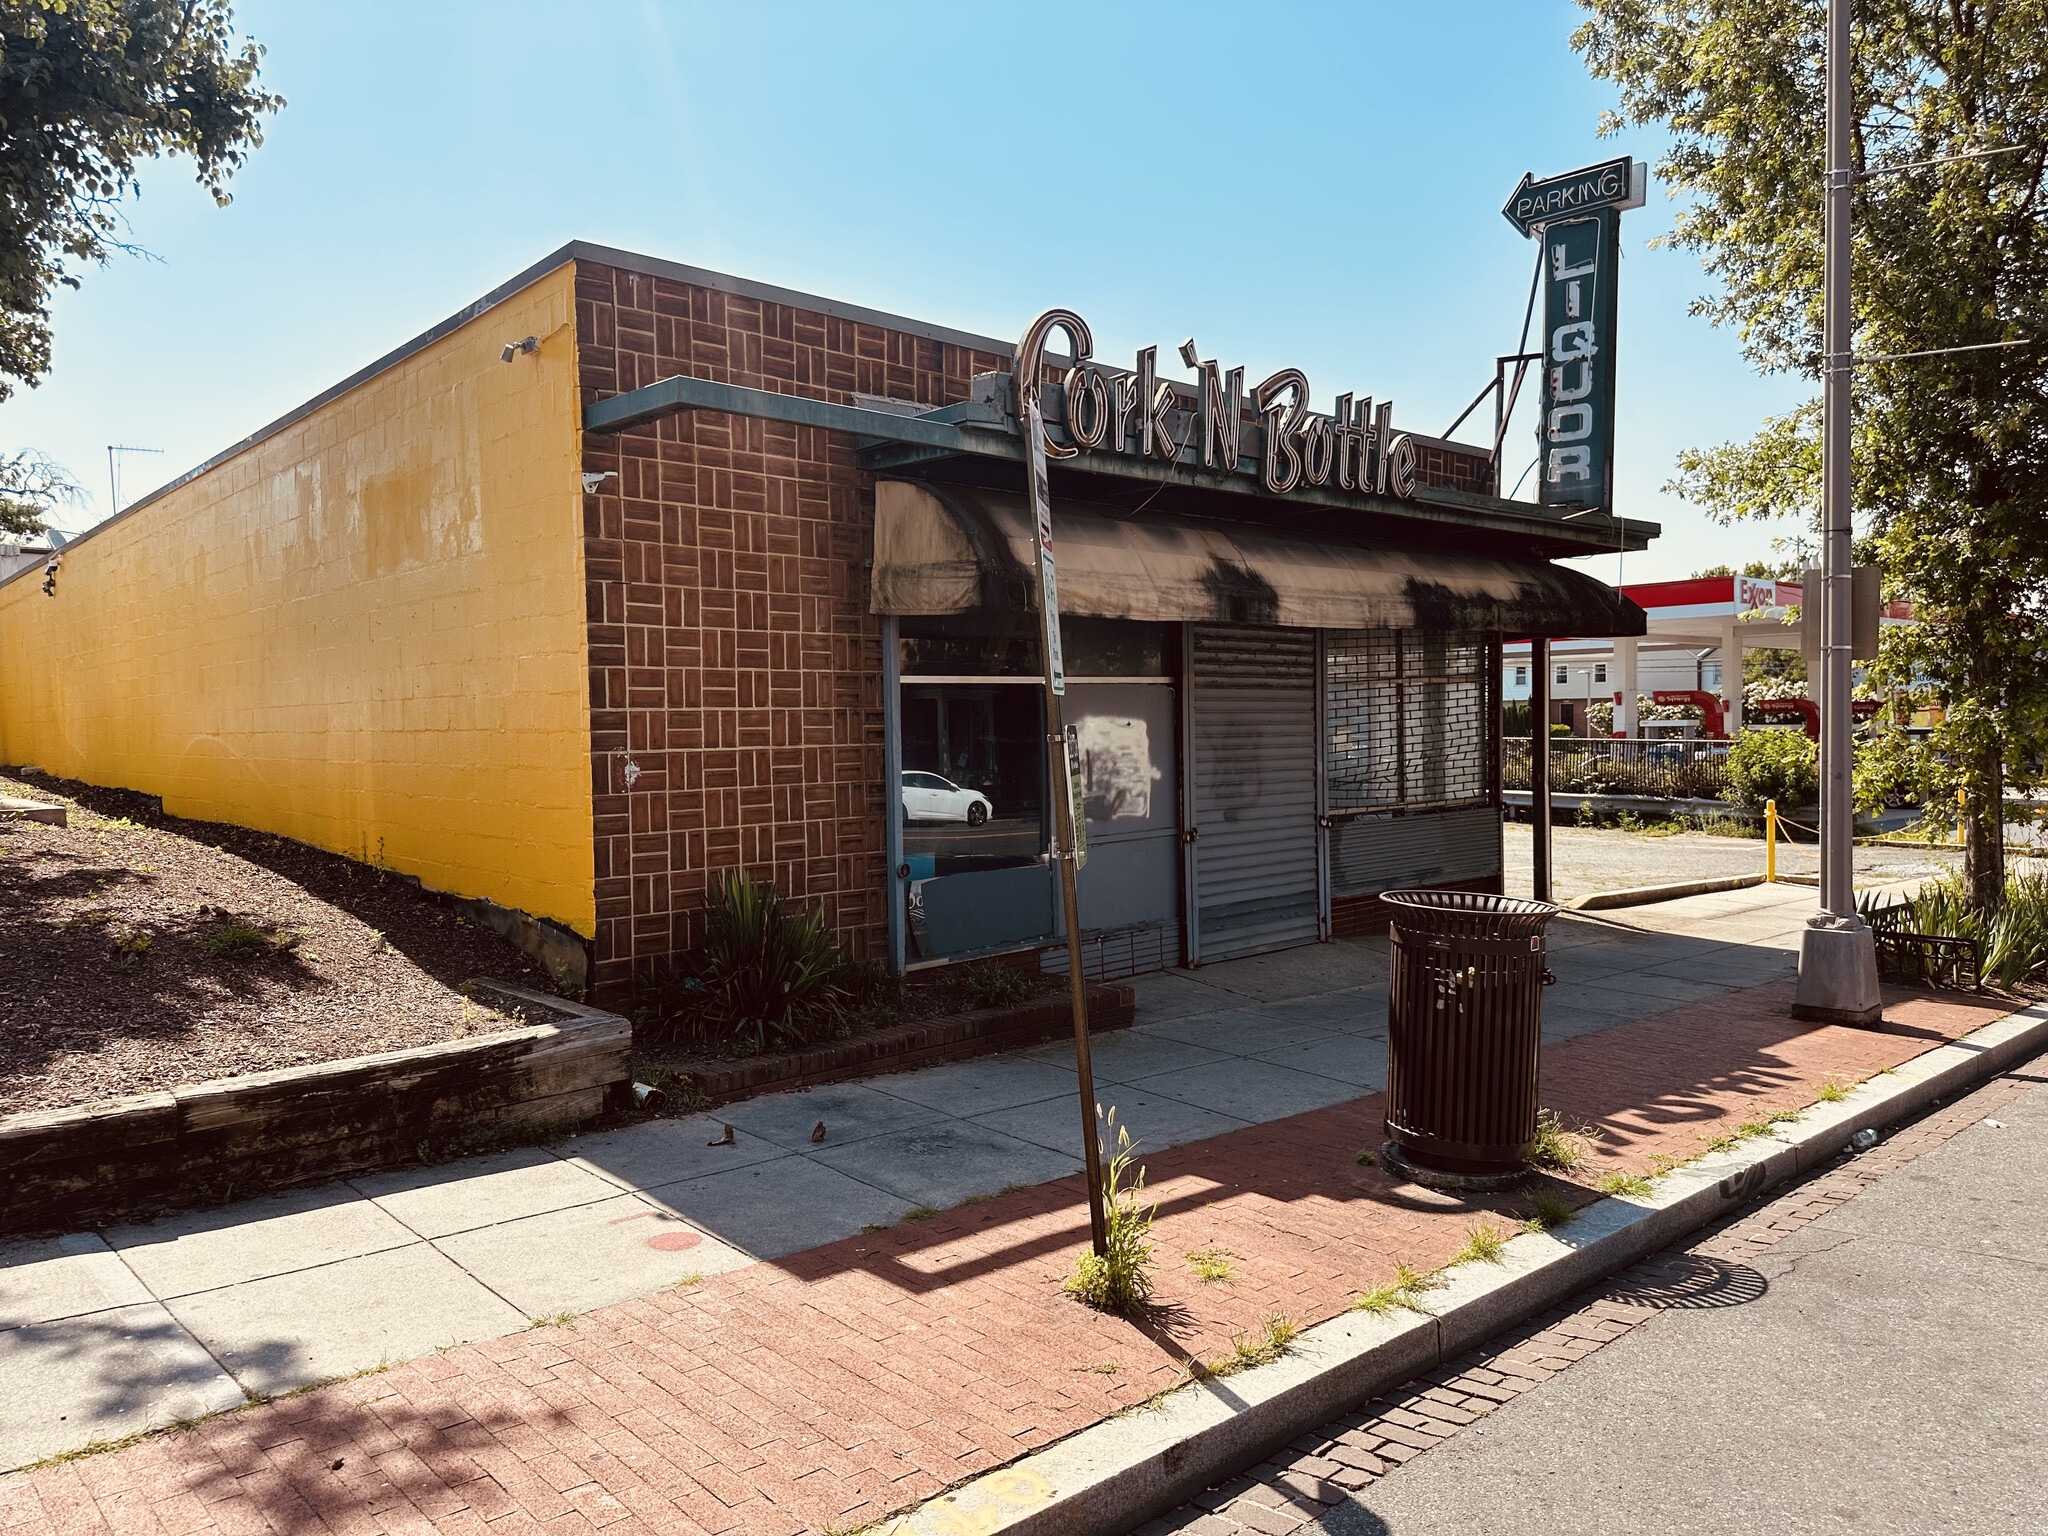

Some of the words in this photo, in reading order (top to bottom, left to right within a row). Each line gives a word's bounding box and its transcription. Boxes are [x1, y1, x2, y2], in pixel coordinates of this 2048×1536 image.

[1517, 172, 1621, 219] PARKING
[1546, 243, 1599, 484] LIQUOR
[1013, 308, 1177, 460] Cork
[1250, 367, 1416, 499] Bottle
[1739, 579, 1774, 610] Exxon
[1666, 695, 1691, 703] Synergy
